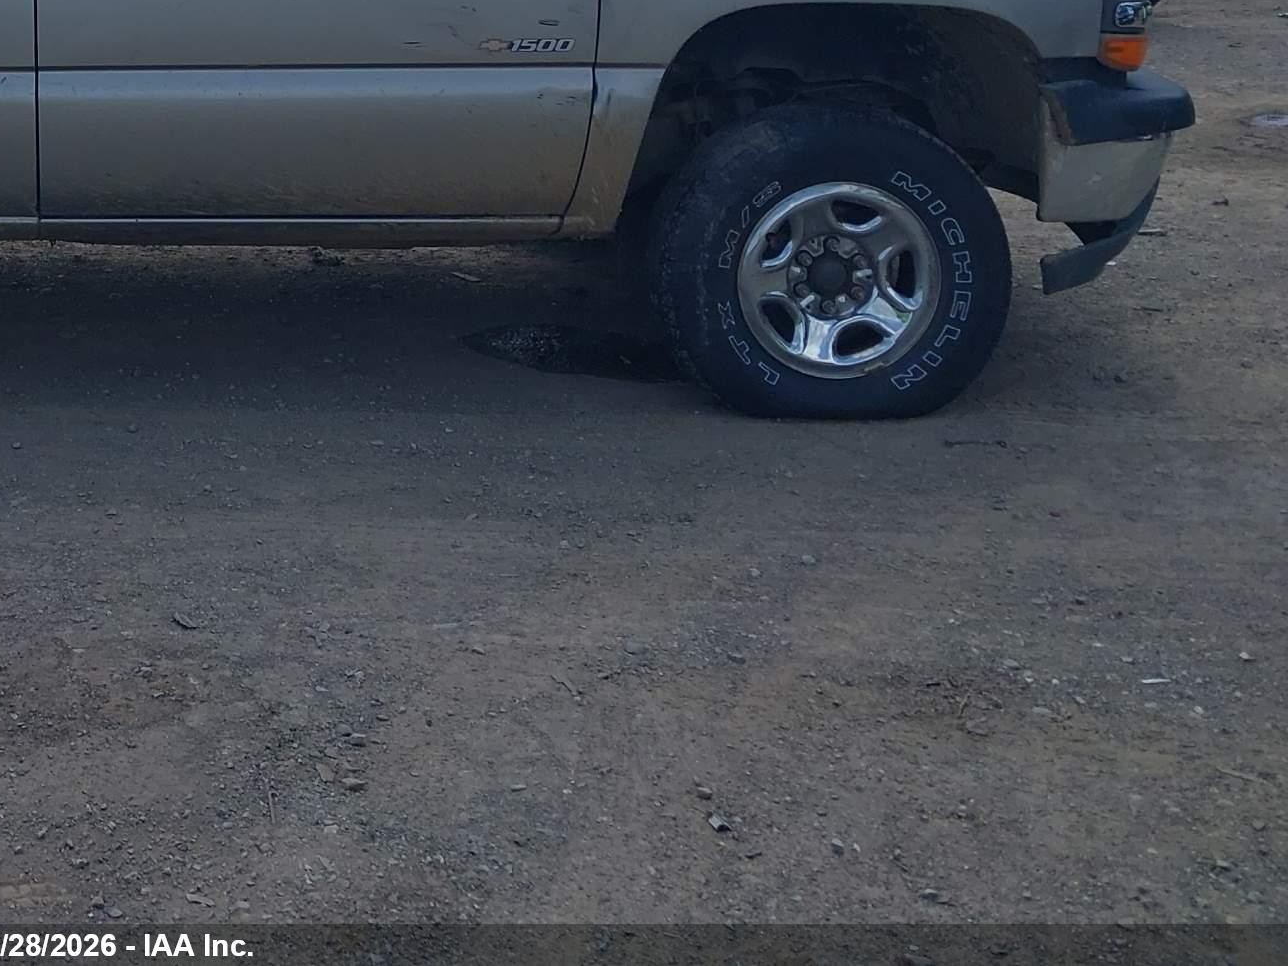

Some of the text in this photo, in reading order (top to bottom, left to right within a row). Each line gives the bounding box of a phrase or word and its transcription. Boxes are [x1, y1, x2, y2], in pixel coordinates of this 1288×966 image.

[511, 38, 576, 52] 1500
[890, 170, 973, 391] MICHELIN
[716, 300, 780, 386] LTX
